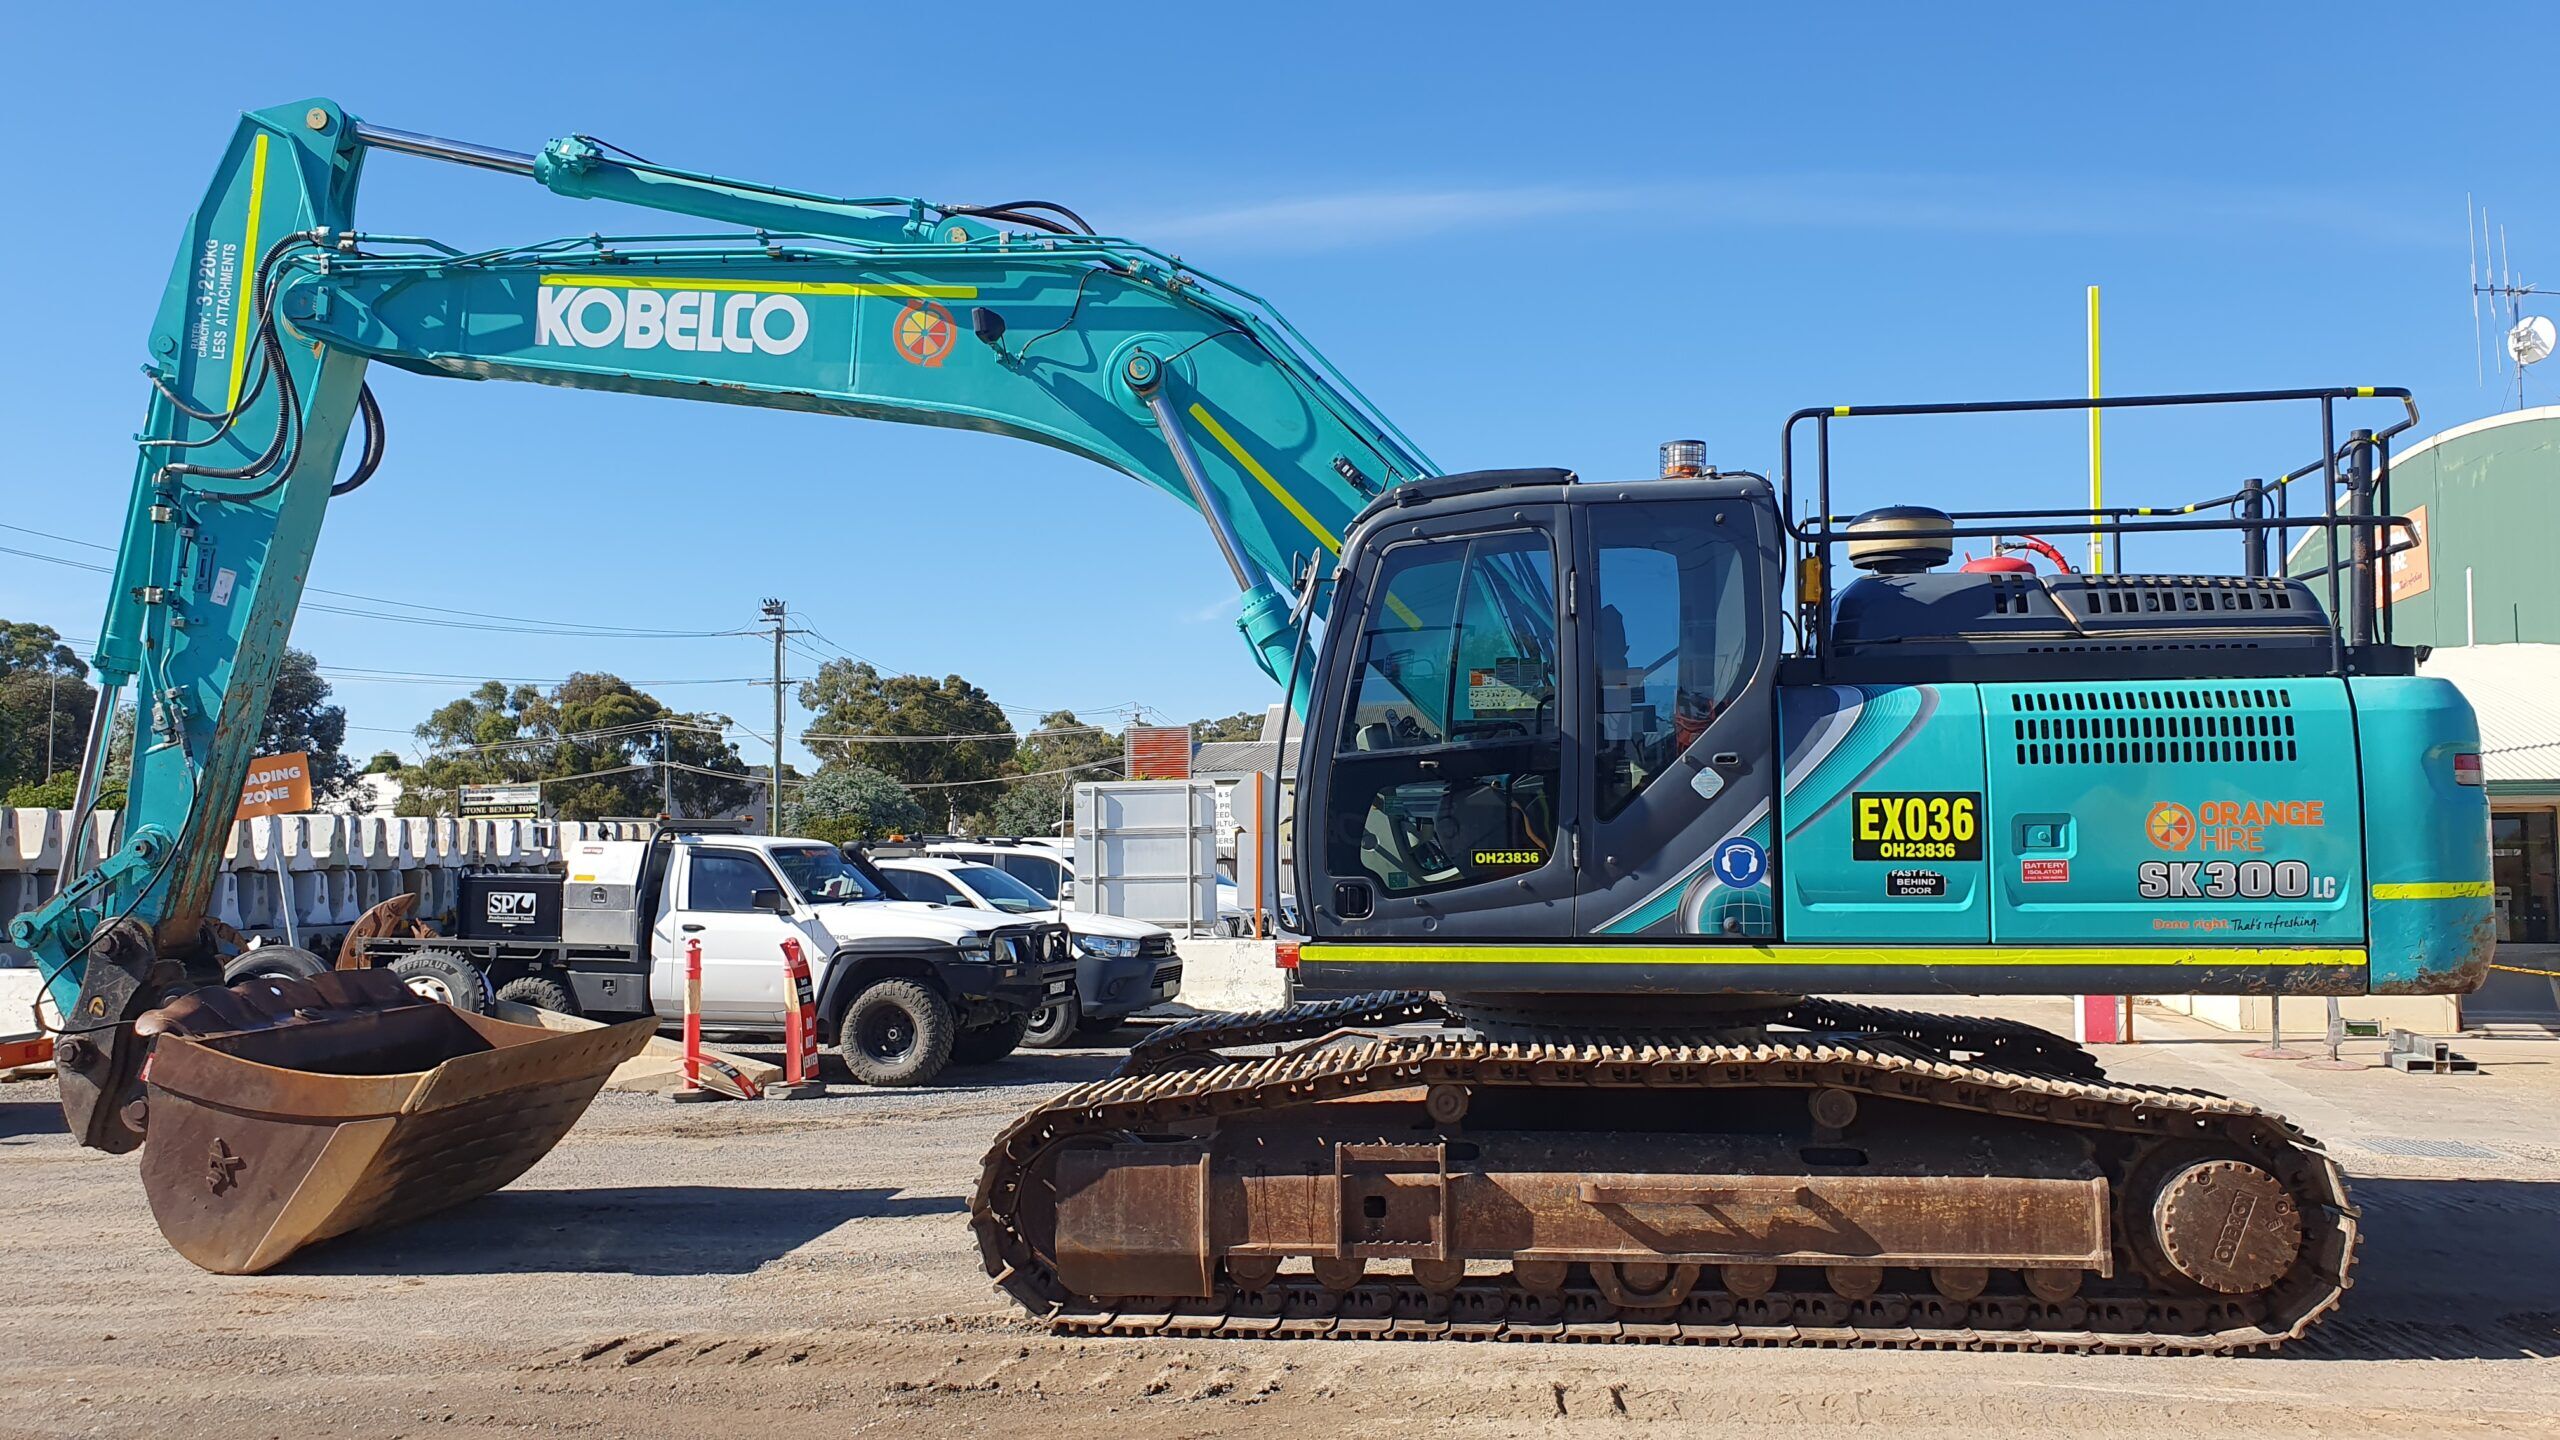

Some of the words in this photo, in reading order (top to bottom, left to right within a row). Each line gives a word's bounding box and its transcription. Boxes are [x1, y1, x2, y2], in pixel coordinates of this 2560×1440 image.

[196, 239, 219, 307] 3,220KG
[215, 243, 237, 326] ATTACHMENTS
[535, 286, 809, 355] KOBELCO
[190, 322, 202, 350] RATED
[211, 330, 227, 360] LESS
[242, 786, 290, 806] ZONE
[461, 806, 487, 814] STONE
[489, 805, 516, 813] BENCH
[518, 804, 538, 812] TOPS
[1860, 798, 1975, 841] EX036
[2200, 801, 2325, 826] ORANGE
[2200, 827, 2264, 851] HIRE
[1475, 852, 1539, 864] OH23836
[1880, 842, 1956, 858] OH23836
[1891, 869, 1918, 877] FAST
[1896, 878, 1936, 886] BEHIND
[2312, 877, 2336, 899] LC
[490, 894, 515, 913] SP
[2153, 918, 2190, 930] Done
[2231, 918, 2261, 932] That's
[2264, 914, 2320, 933] refreshing.
[401, 959, 449, 973] EFFIPLUS
